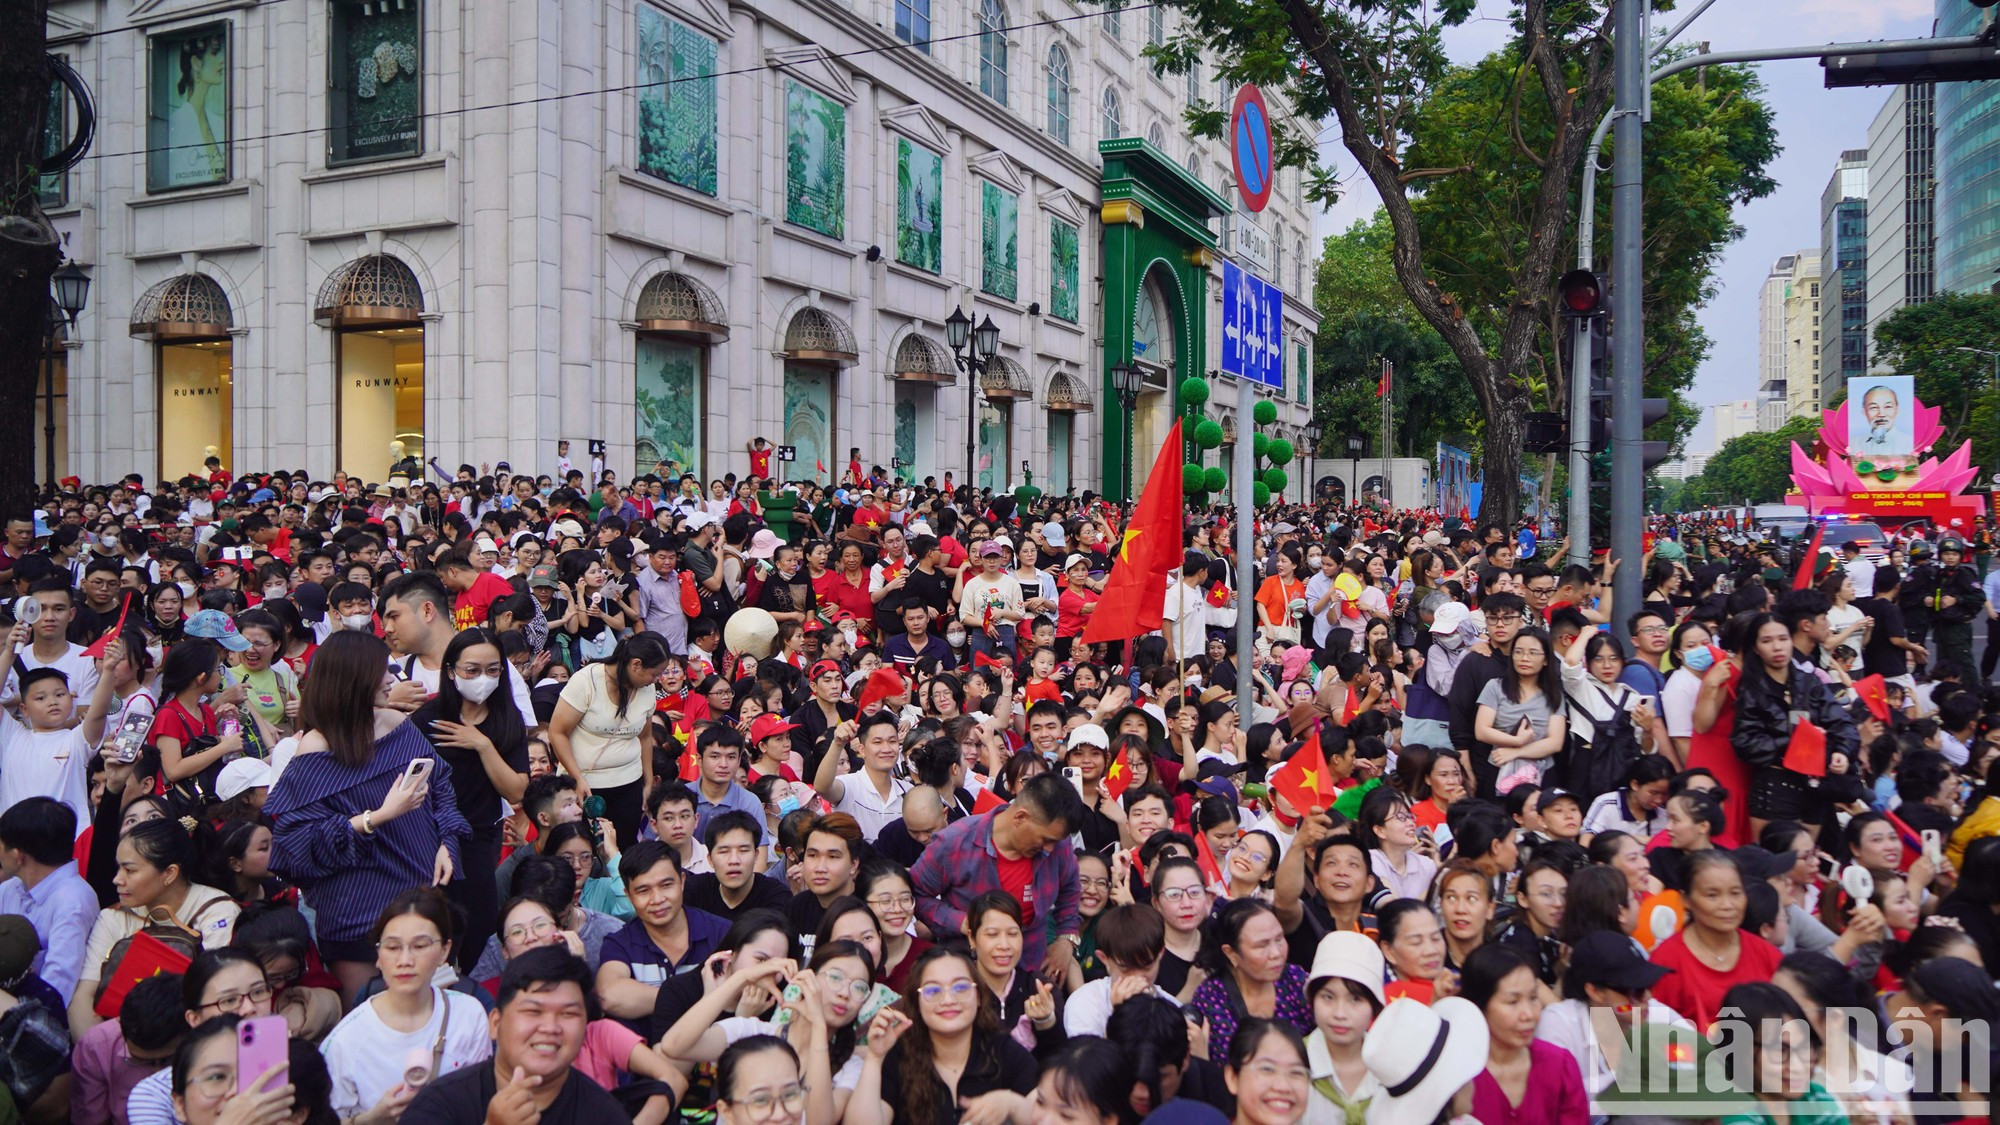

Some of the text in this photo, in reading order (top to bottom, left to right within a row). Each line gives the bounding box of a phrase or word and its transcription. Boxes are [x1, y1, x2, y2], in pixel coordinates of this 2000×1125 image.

[354, 134, 391, 146] EXCLUSIVELY
[391, 133, 400, 141] AT
[356, 377, 408, 388] RUNWAY
[174, 386, 219, 397] RUNWAY
